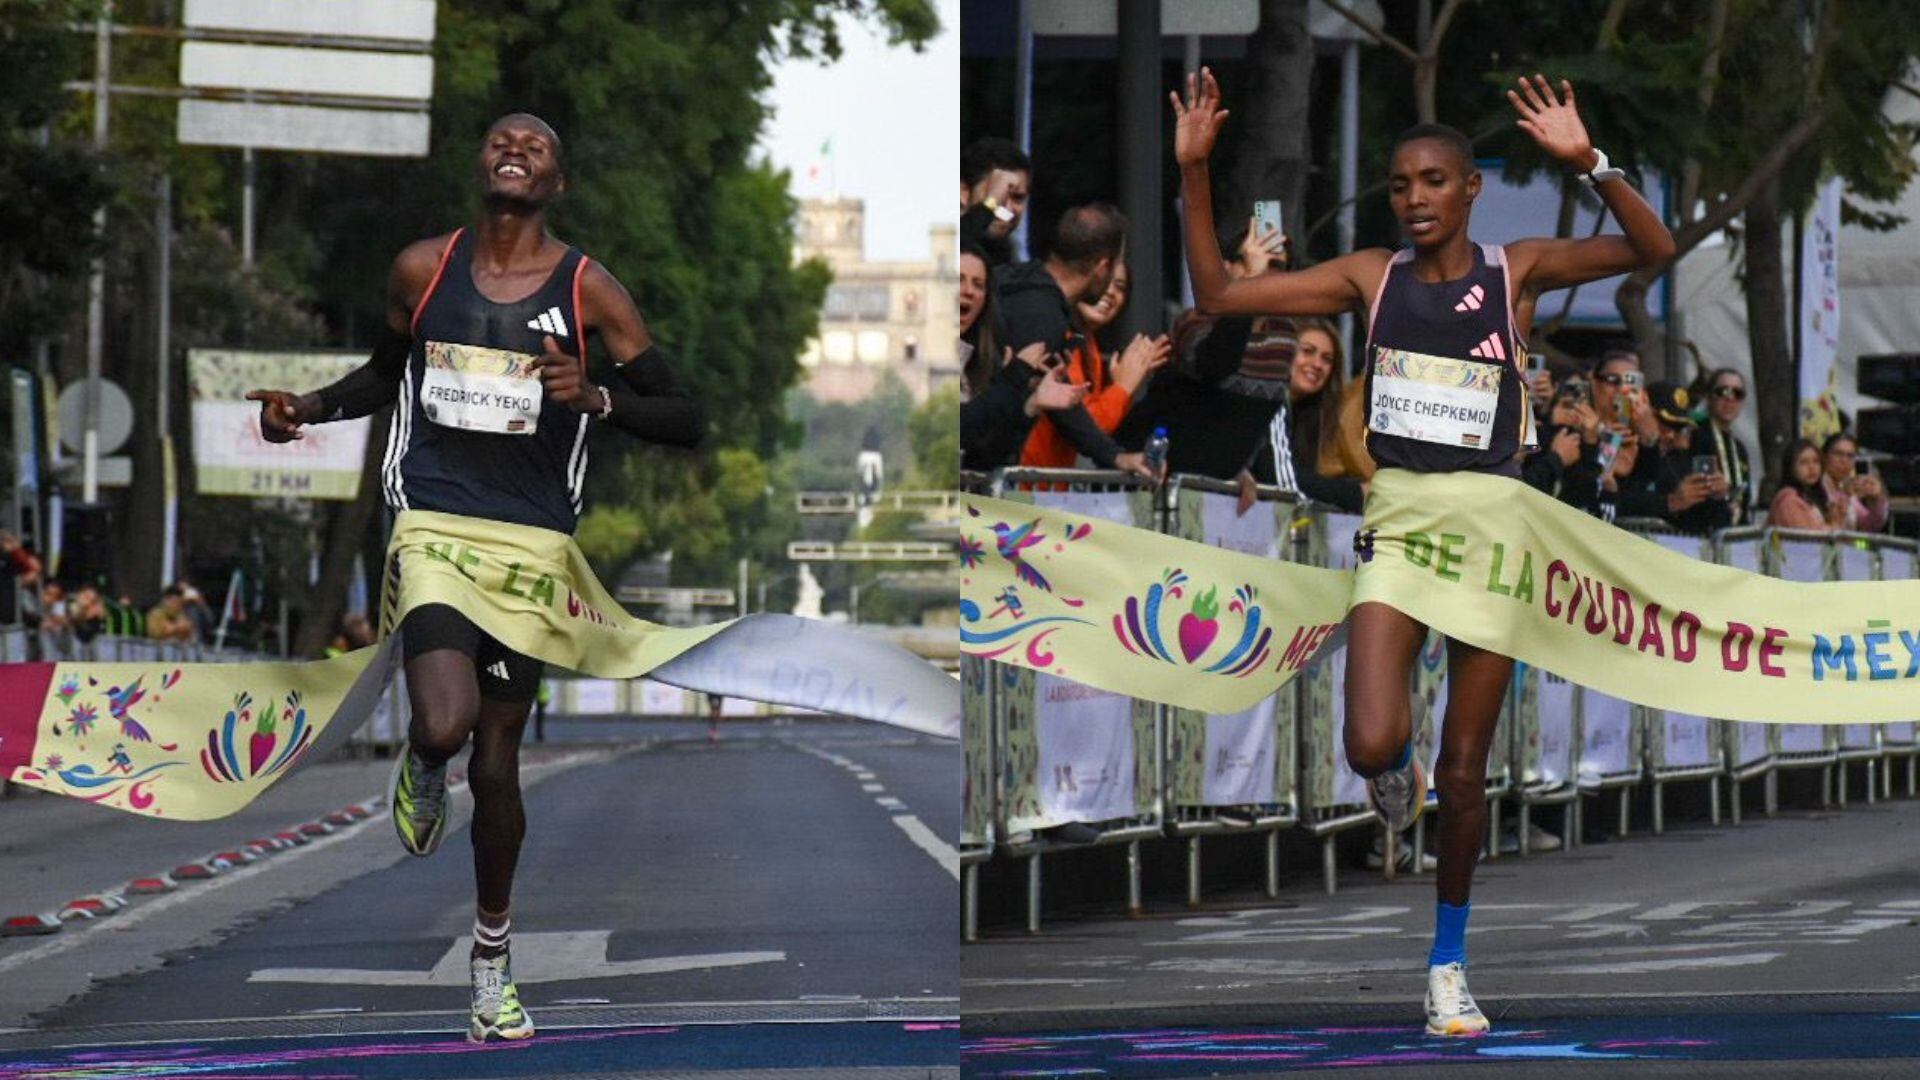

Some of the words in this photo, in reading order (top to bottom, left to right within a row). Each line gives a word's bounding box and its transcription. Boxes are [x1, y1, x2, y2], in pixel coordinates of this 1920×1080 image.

[428, 386, 490, 406] FREDRICK
[494, 394, 531, 411] YEKO
[1375, 394, 1411, 412] JOYCE
[1413, 400, 1491, 424] CHEPKEMOI
[252, 473, 272, 490] 21
[280, 474, 311, 490] KM
[502, 562, 556, 608] LA
[1403, 531, 1466, 583] DE
[1486, 542, 1534, 604] LA
[1545, 559, 1702, 664] CIUDAD
[1720, 620, 1790, 678] DE
[1275, 622, 1342, 673] ME
